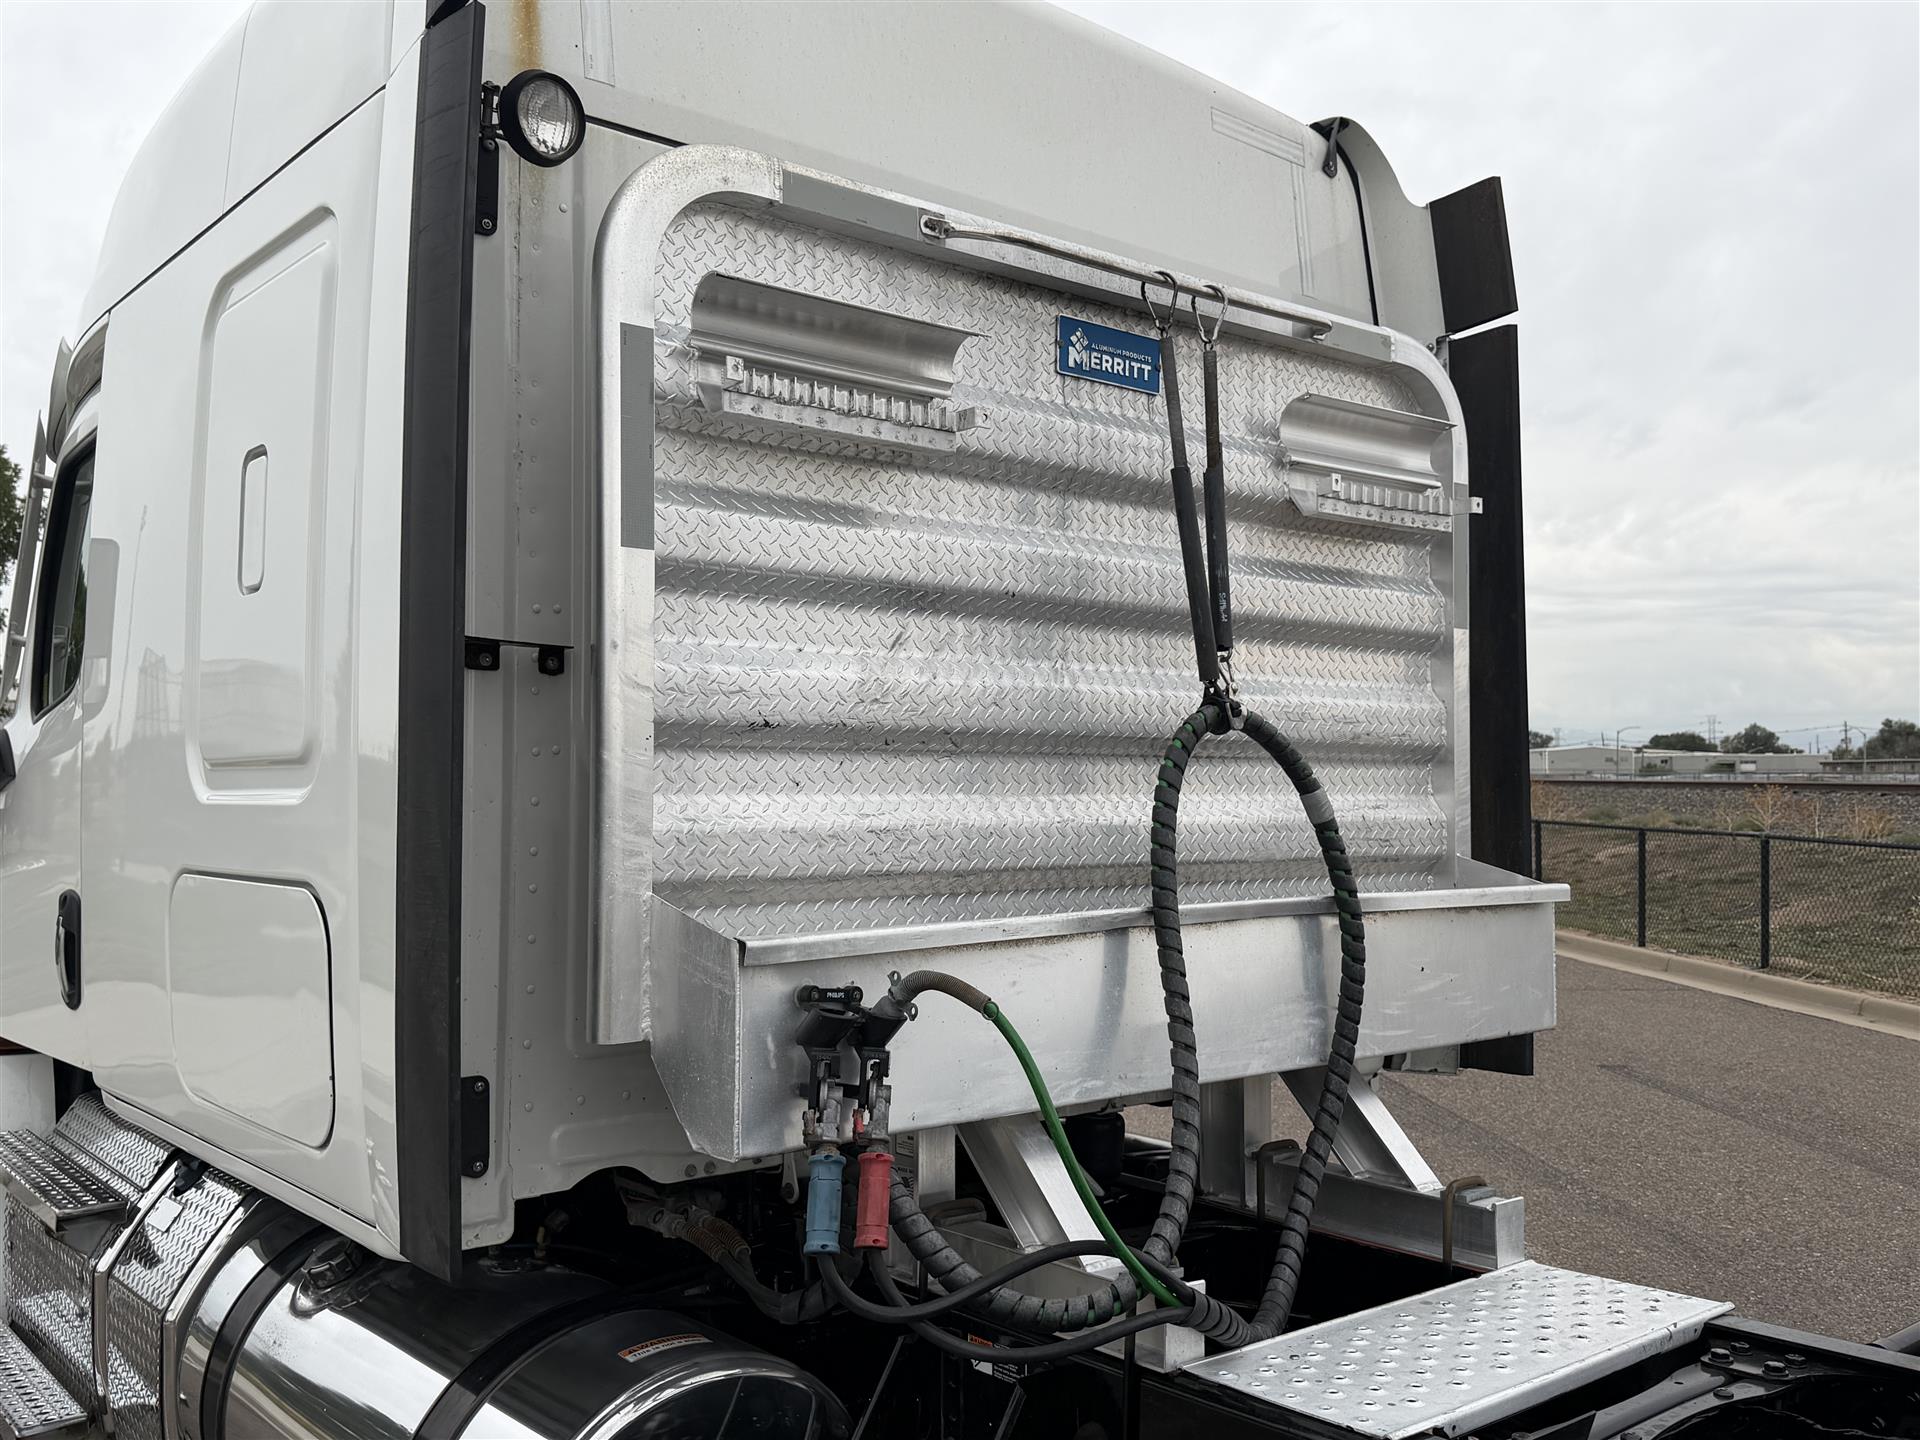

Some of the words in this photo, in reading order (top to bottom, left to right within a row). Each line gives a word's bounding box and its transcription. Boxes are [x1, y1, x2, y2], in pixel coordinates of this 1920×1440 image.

[1068, 345, 1152, 381] MERRITT
[1091, 343, 1122, 355] ALUMINUM
[1122, 350, 1152, 363] PRODUCTS
